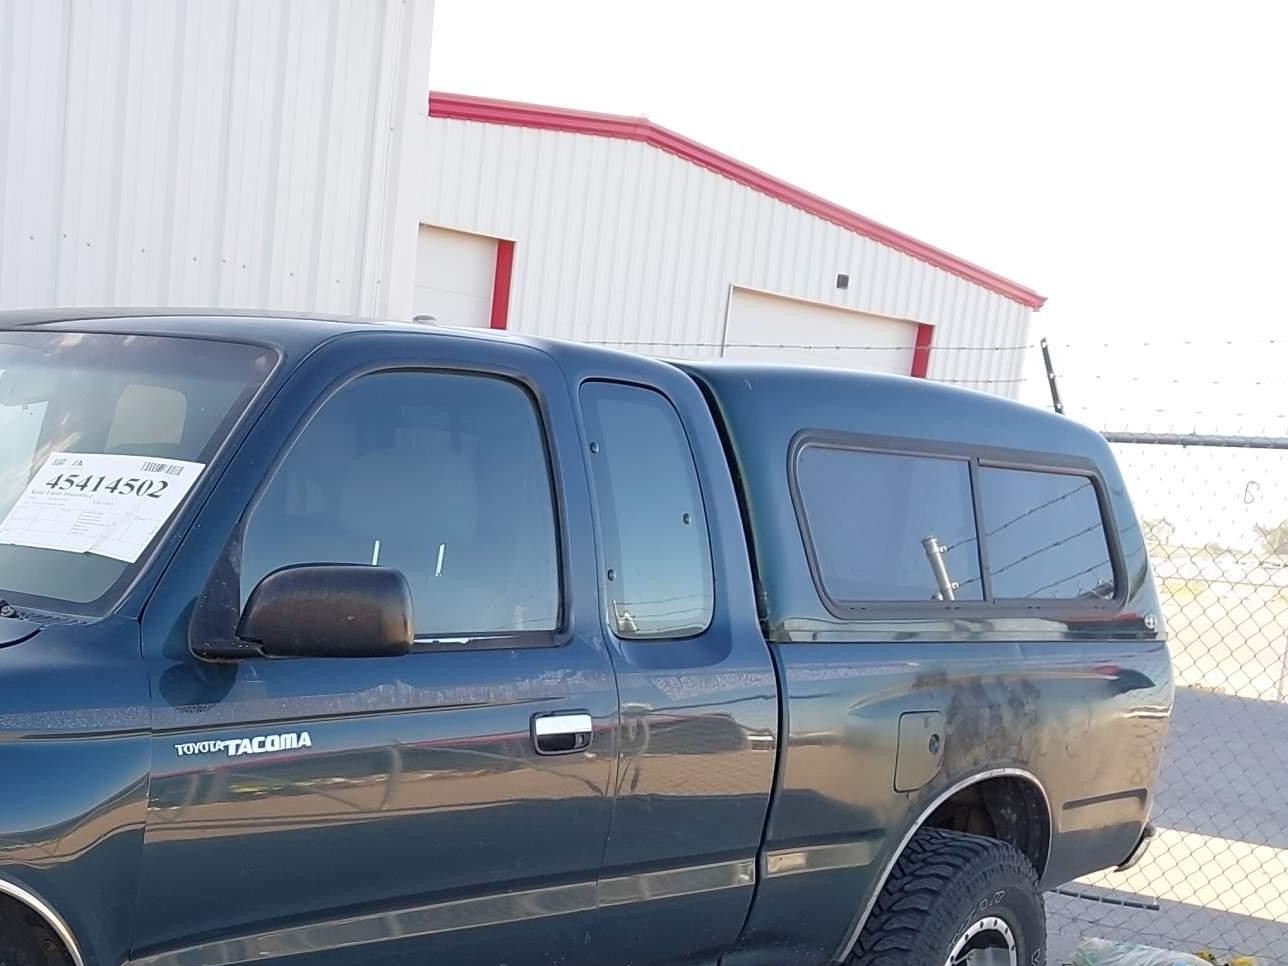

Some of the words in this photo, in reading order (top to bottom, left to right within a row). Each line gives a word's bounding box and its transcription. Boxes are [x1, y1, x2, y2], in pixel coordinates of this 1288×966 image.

[45, 473, 170, 499] 45414502
[175, 740, 223, 755] TOYOTA
[223, 732, 312, 756] TACOMA
